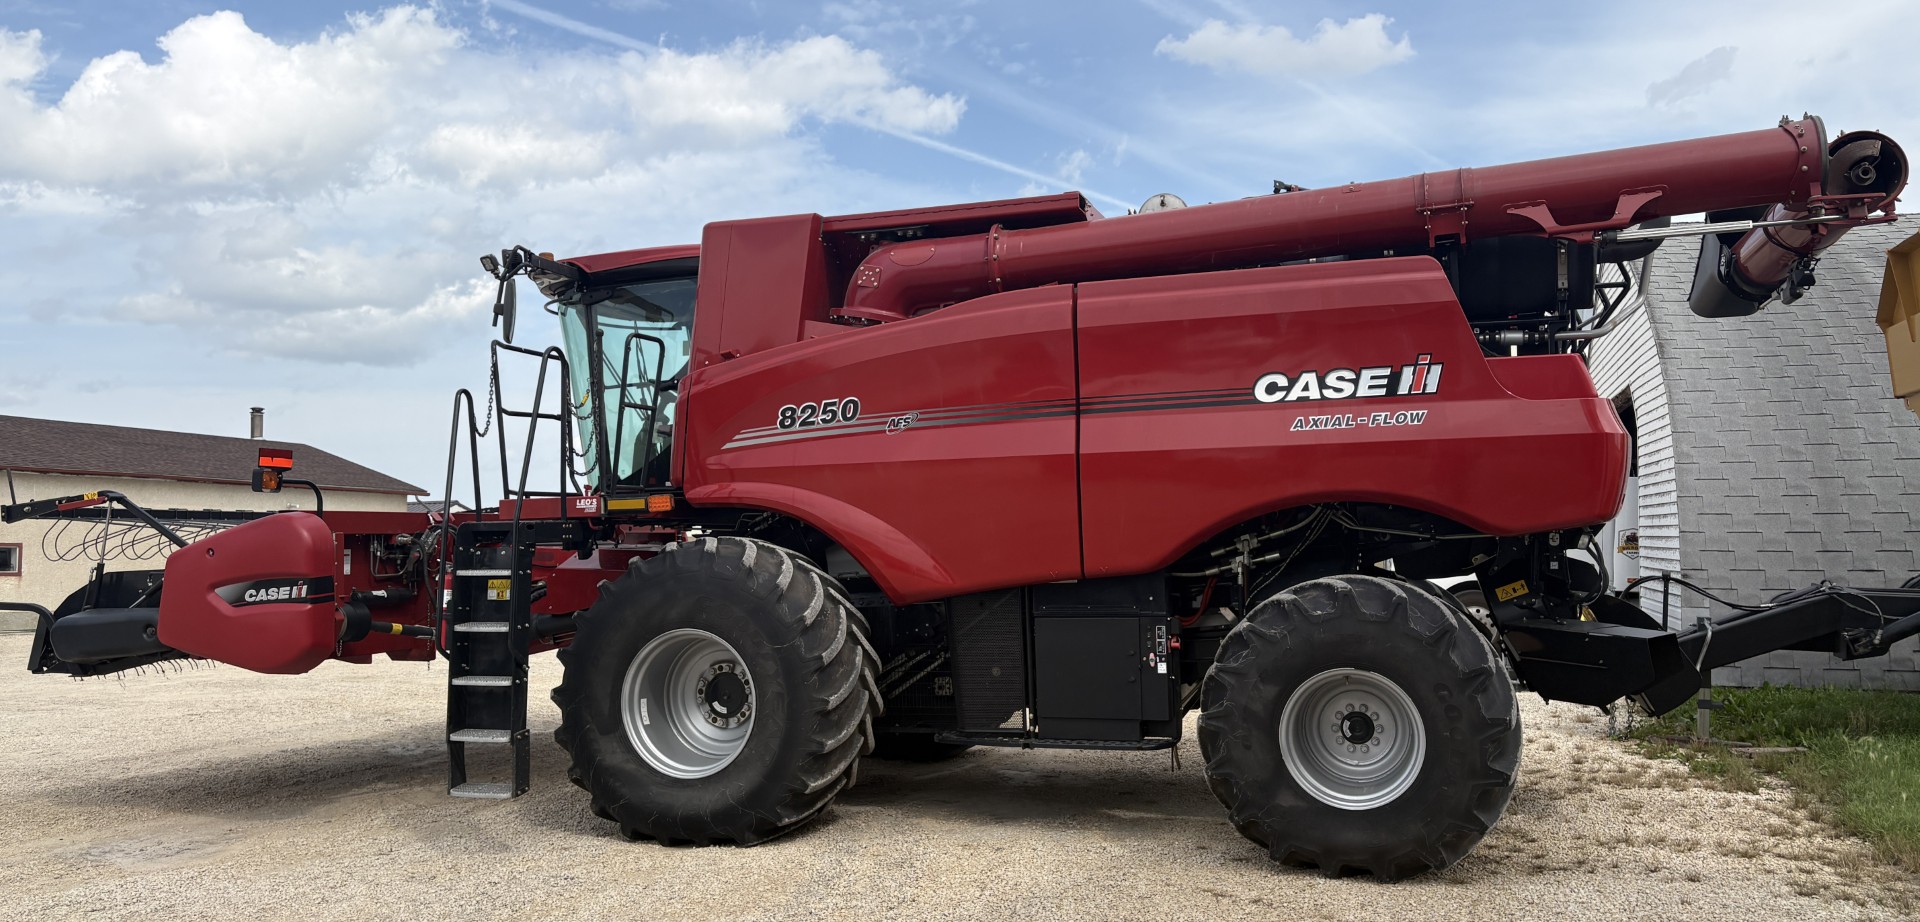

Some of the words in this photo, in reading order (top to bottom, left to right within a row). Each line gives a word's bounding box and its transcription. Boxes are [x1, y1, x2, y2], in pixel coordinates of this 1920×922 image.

[1253, 367, 1392, 403] CASE
[777, 397, 860, 430] 8250
[886, 415, 914, 430] AFS
[576, 498, 597, 506] LEO'S
[244, 586, 291, 602] CASE
